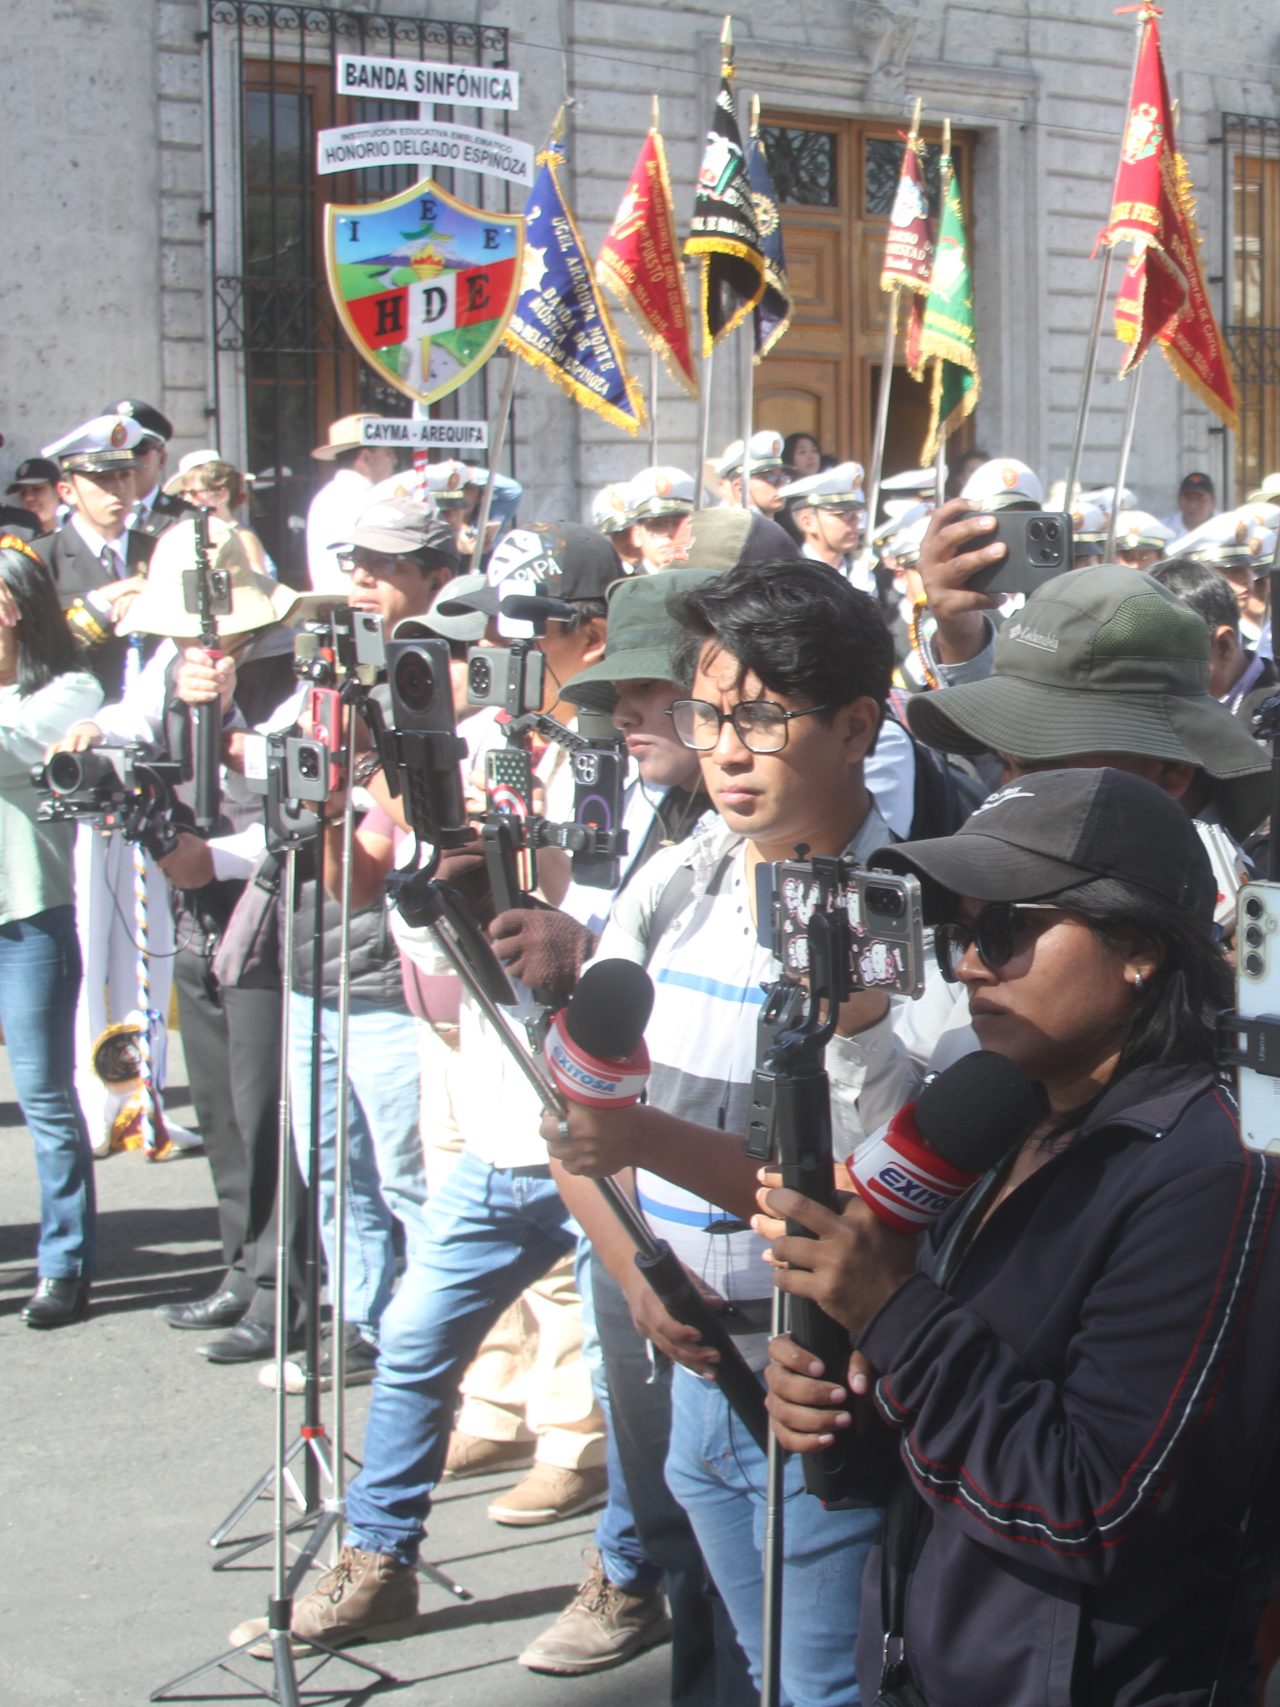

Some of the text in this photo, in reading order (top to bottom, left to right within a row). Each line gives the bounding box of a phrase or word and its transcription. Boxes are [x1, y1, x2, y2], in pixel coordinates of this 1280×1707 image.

[346, 63, 513, 102] BANDA SINFÓNICA
[400, 127, 449, 138] EDUCATIVA
[326, 140, 527, 177] HONORIO DELGADO ESPINOZA
[350, 201, 499, 249] I E E
[640, 239, 665, 283] PUESTO
[375, 274, 490, 336] H D E
[552, 216, 574, 253] UGEL
[588, 326, 615, 373] NORTE
[364, 423, 409, 440] CAYMA
[553, 1046, 616, 1093] EXITOSA
[879, 1167, 951, 1211] EXITO
